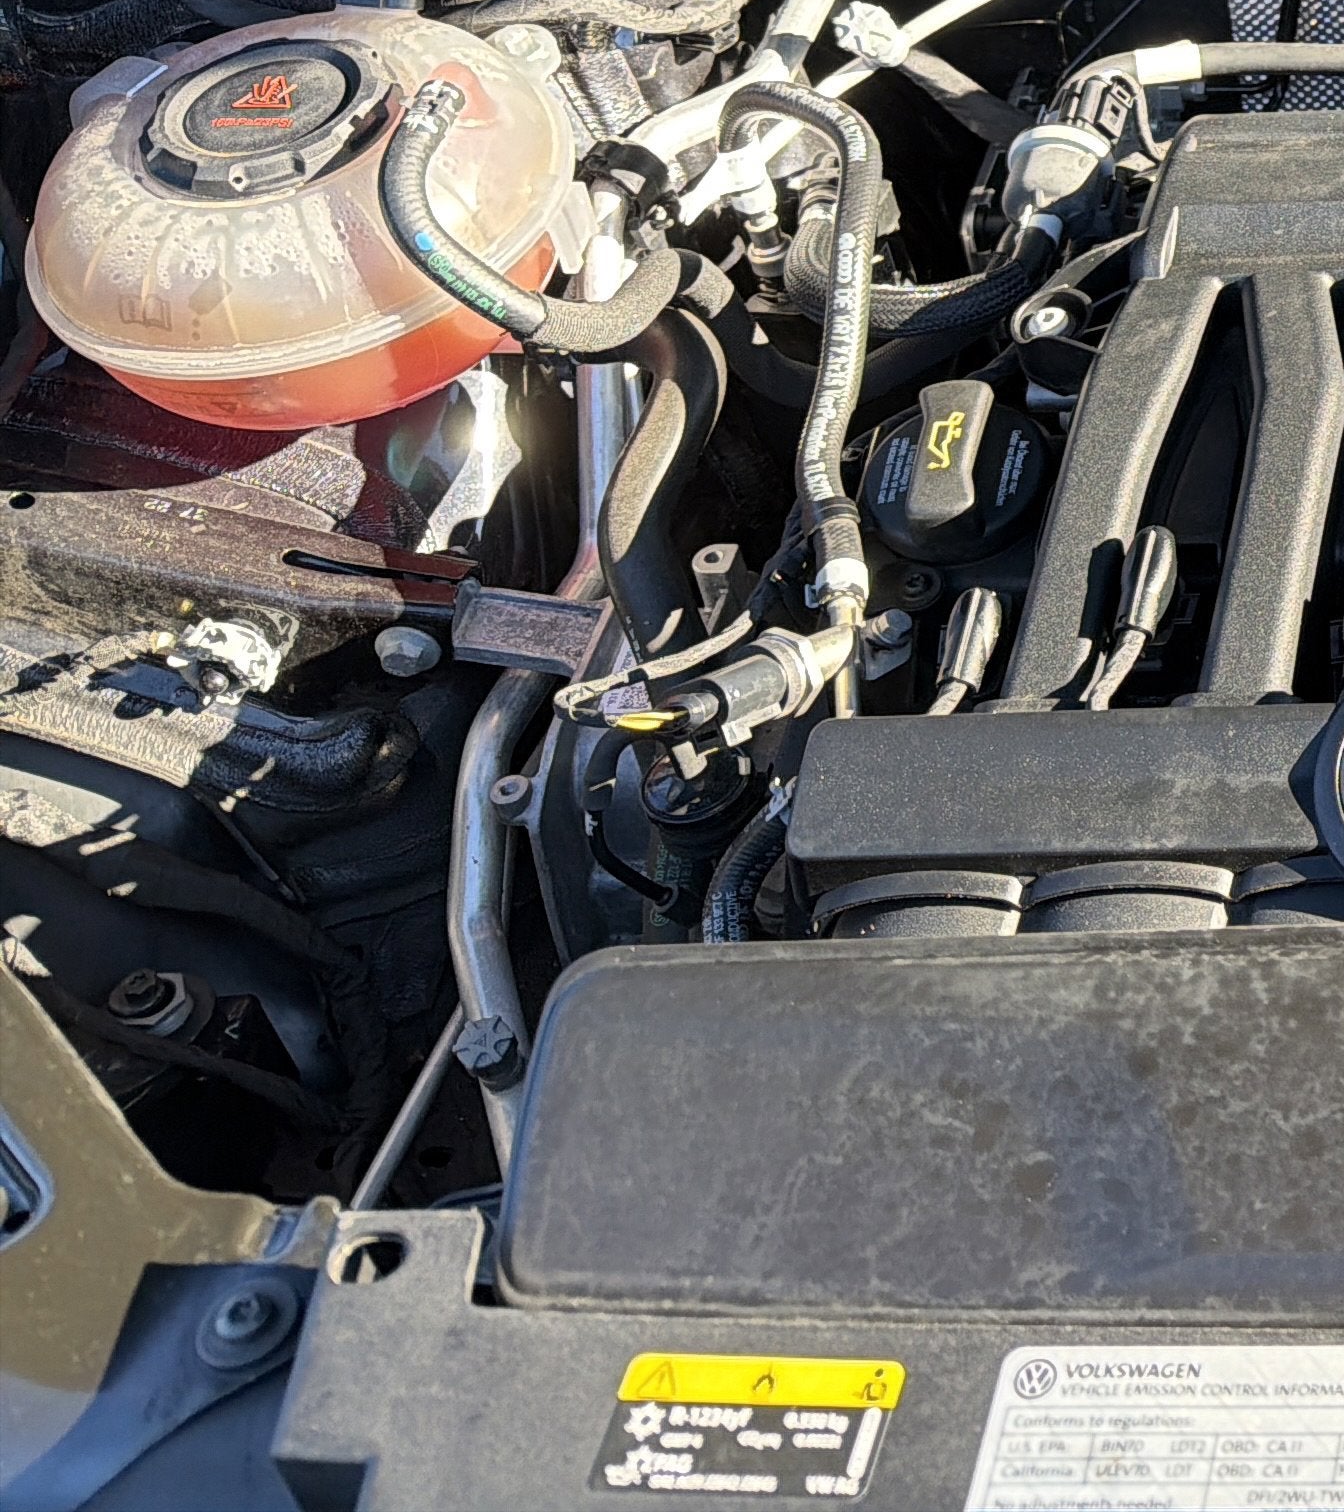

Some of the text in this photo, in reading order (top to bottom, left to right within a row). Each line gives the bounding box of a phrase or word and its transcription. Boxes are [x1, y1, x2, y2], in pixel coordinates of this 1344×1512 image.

[1013, 1358, 1202, 1400] VW VOLKSWAGEN
[1061, 1384, 1119, 1396] VEHICLE
[1124, 1383, 1197, 1396] EMISSION
[1201, 1383, 1269, 1396] CONTROL
[1013, 1414, 1084, 1427] Conforms
[1089, 1414, 1104, 1427] to
